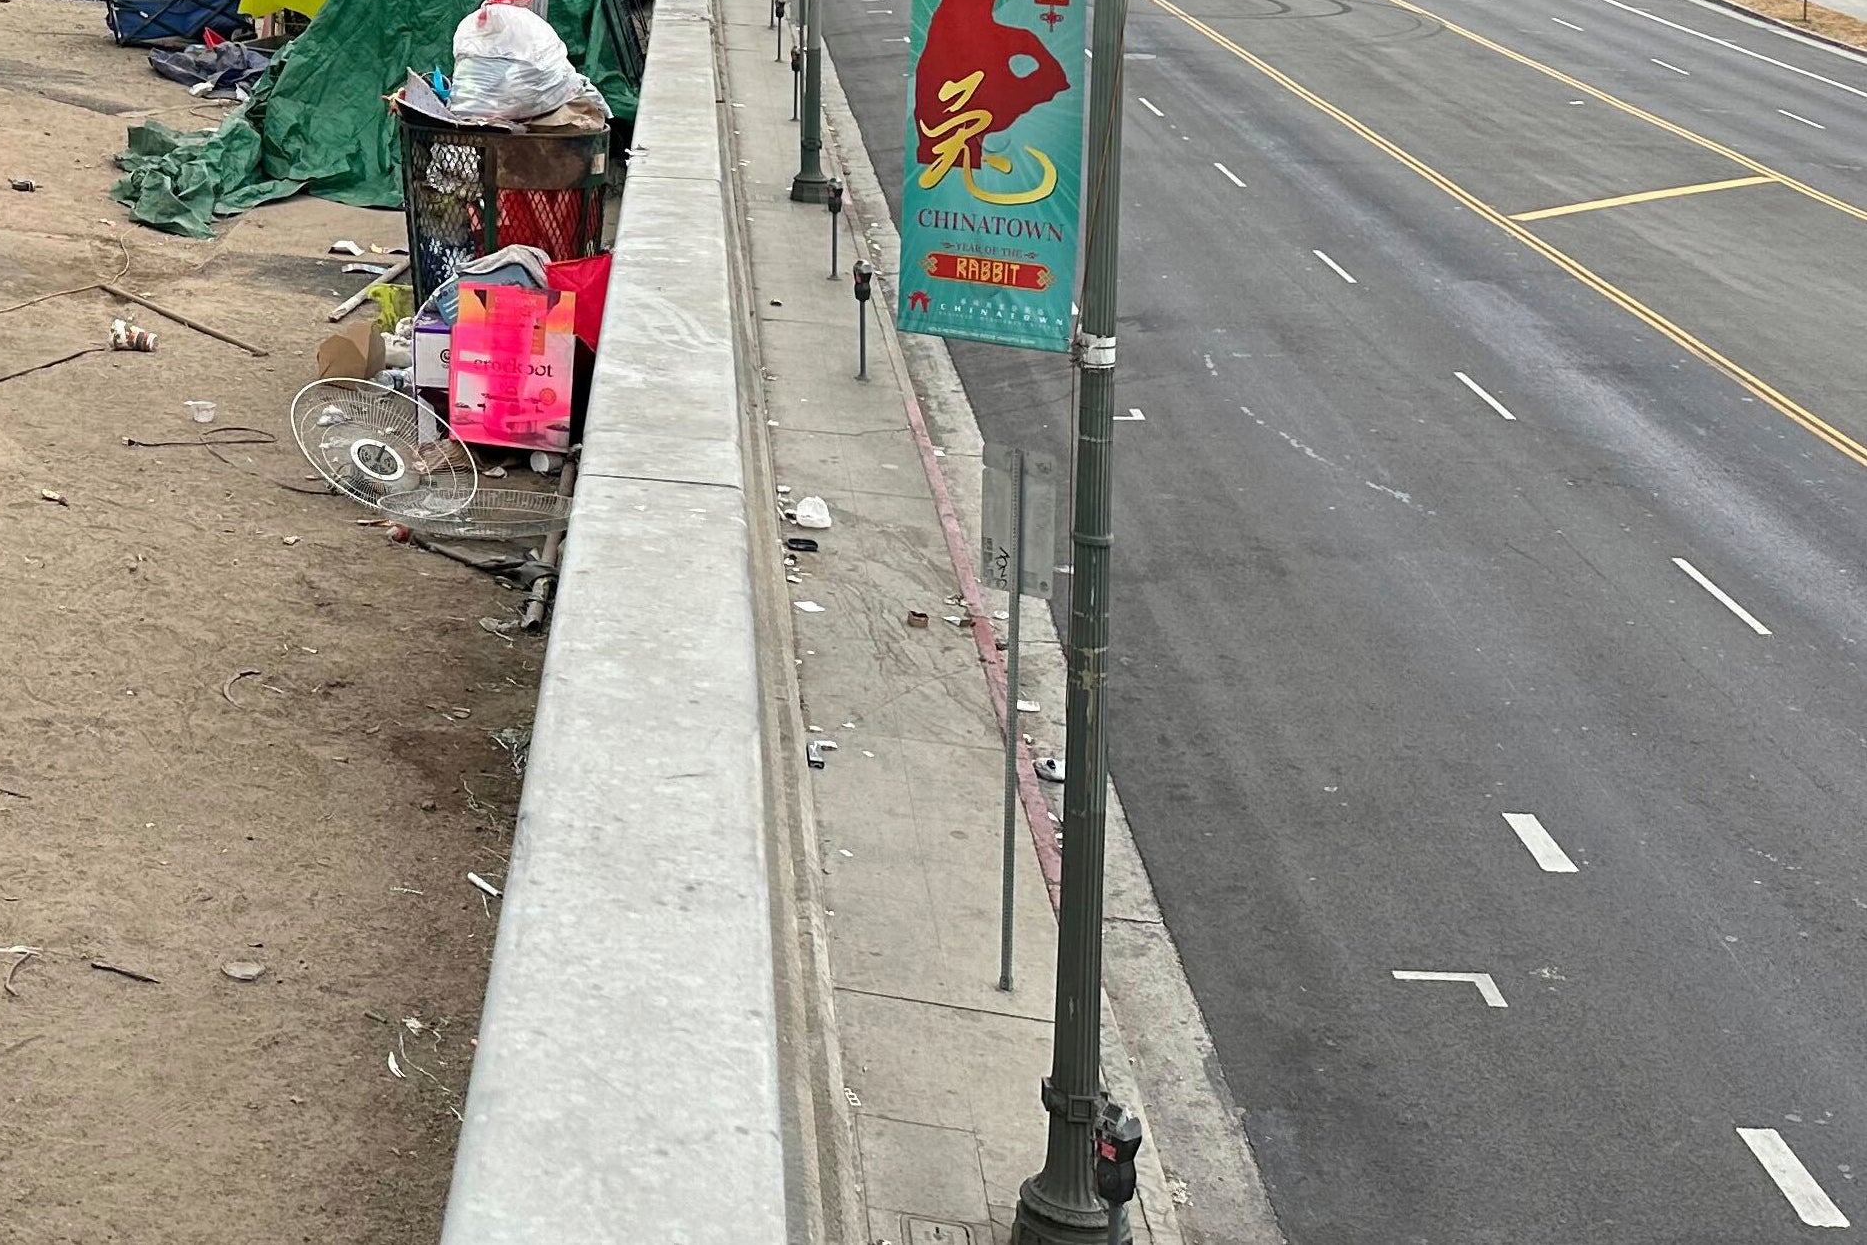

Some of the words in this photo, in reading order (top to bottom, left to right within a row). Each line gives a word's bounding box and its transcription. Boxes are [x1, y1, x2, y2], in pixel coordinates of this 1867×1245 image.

[918, 208, 1065, 243] CHINATOWN
[955, 242, 981, 254] YEAR
[984, 245, 997, 256] OF
[1000, 247, 1023, 259] THE
[956, 257, 1020, 286] RABBIT
